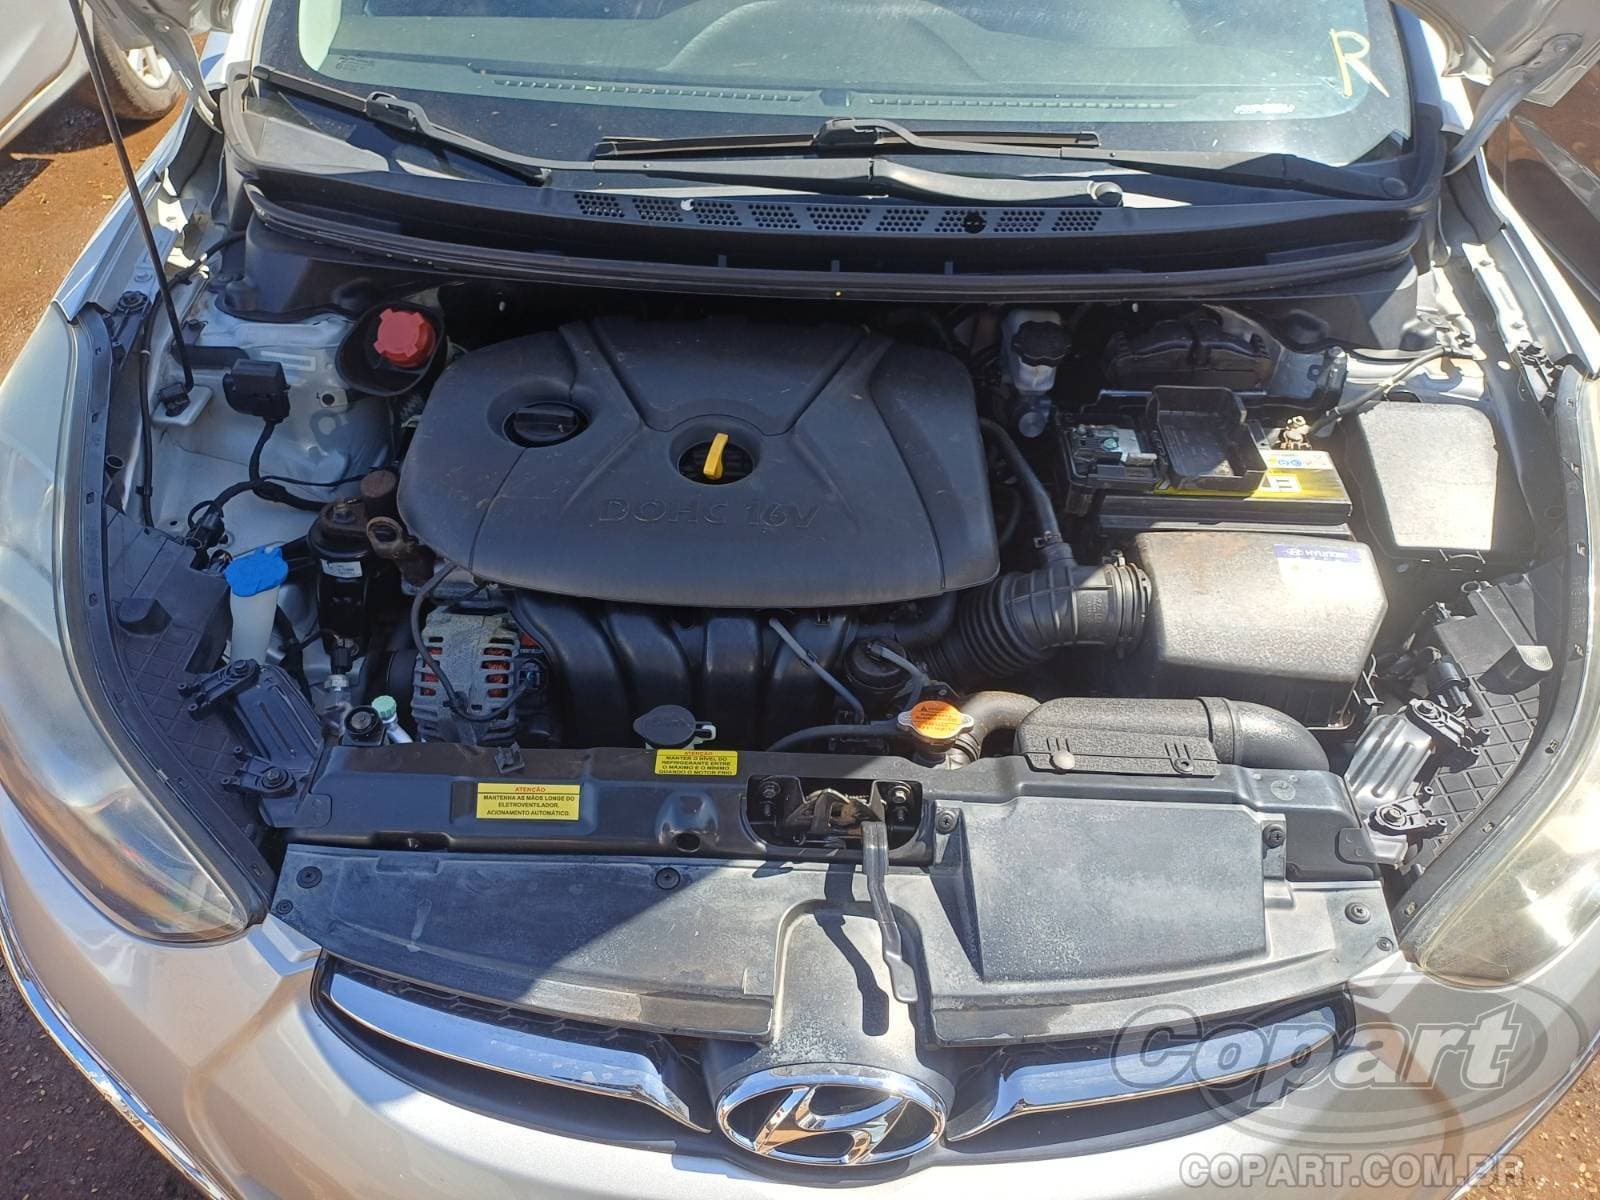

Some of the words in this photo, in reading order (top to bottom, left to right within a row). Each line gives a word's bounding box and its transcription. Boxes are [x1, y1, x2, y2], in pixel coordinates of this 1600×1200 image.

[1329, 28, 1390, 98] R
[598, 500, 729, 524] DOHC
[745, 502, 822, 528] 16V
